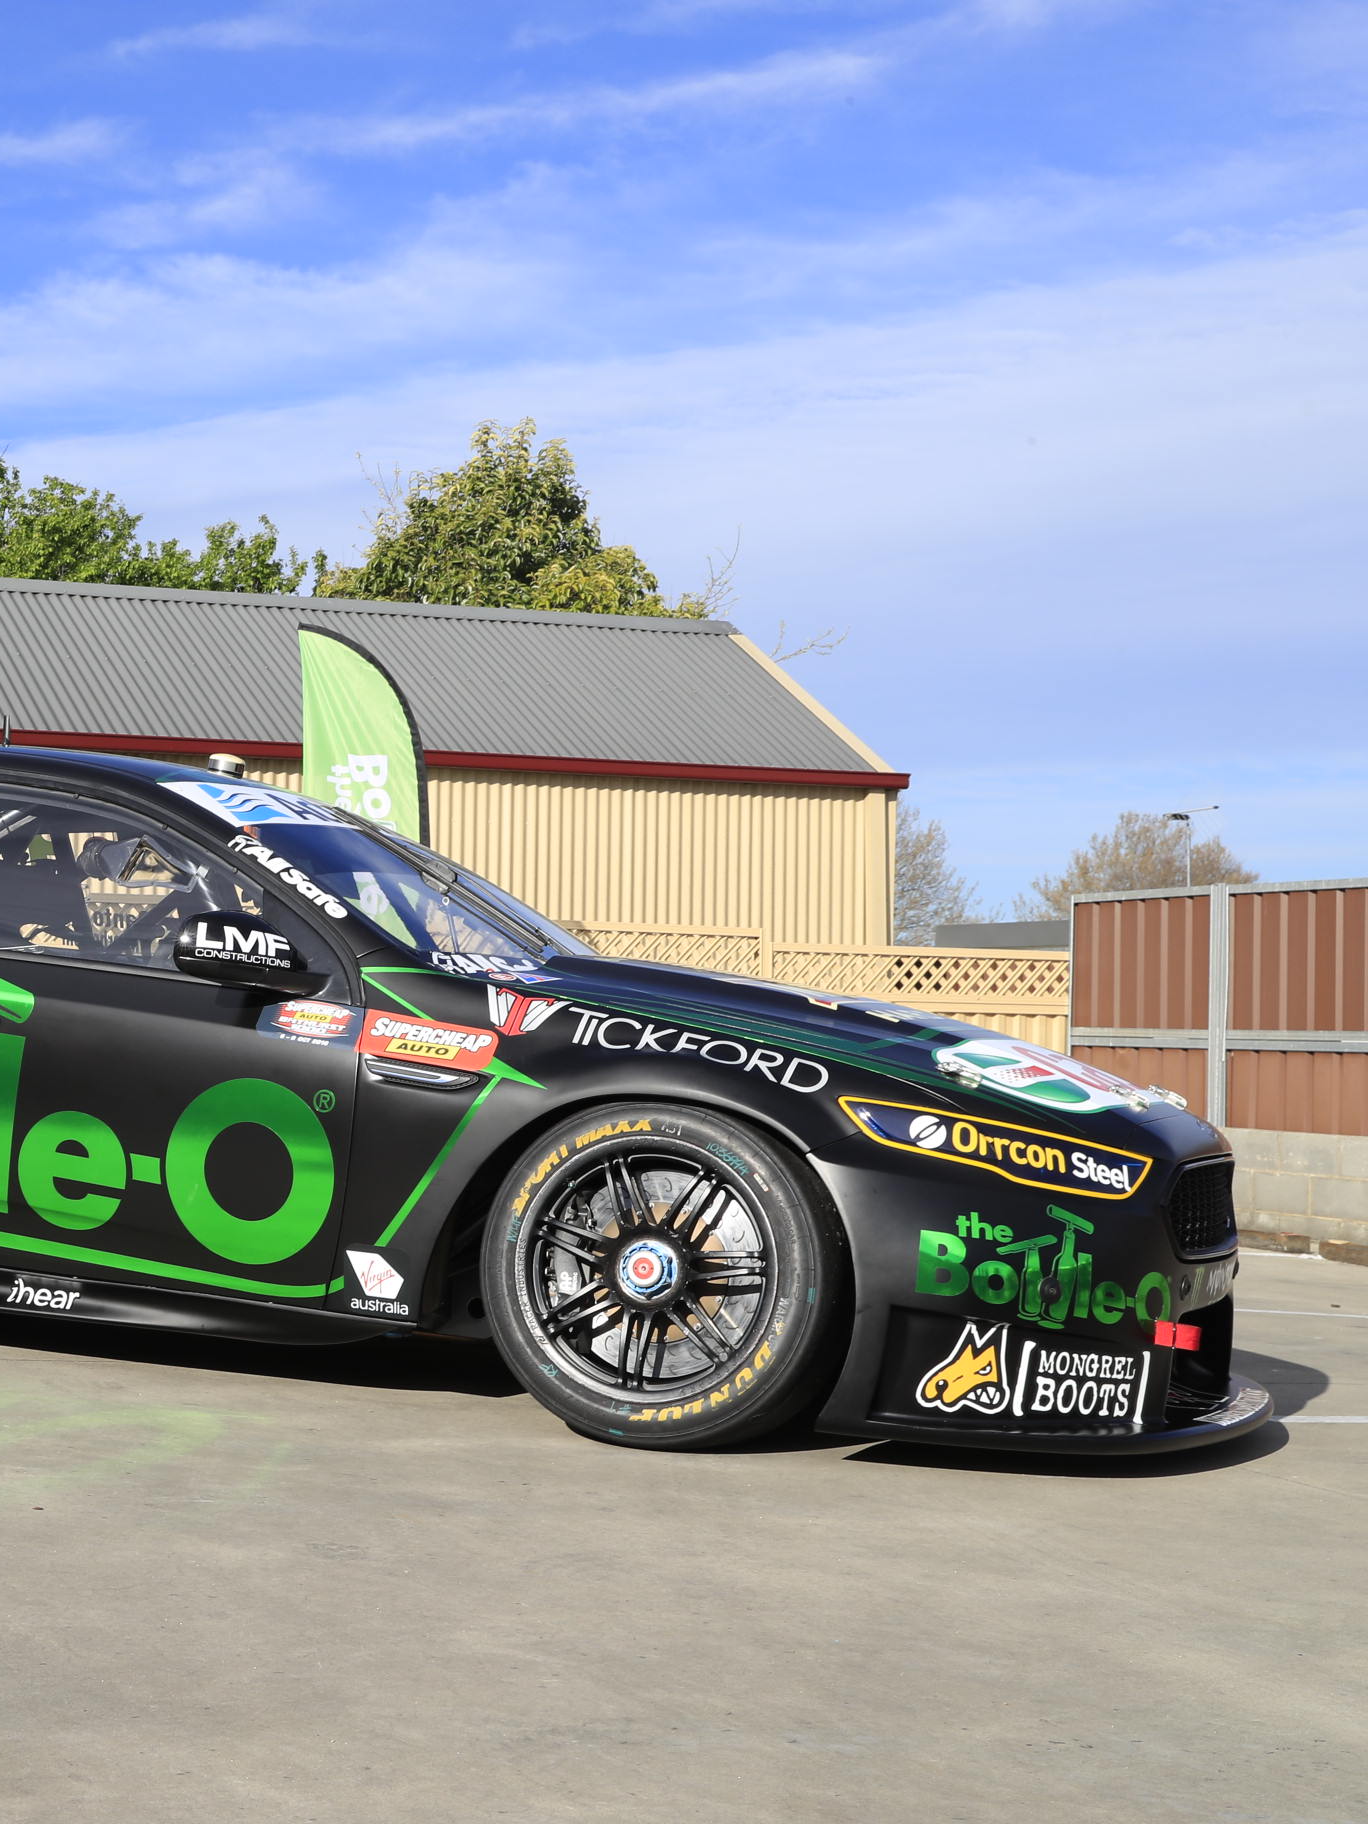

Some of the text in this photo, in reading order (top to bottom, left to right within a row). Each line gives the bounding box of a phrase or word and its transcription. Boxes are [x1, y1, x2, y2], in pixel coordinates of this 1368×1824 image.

[195, 921, 291, 957] LMF
[195, 948, 291, 969] CONSTRUCTIONS
[299, 1013, 328, 1021] AUTO
[370, 1016, 494, 1052] SUPERCHEAP
[396, 1042, 450, 1057] AUTO
[568, 1006, 830, 1094] TICKFORD
[951, 1121, 1066, 1174] Orrcon
[1071, 1152, 1132, 1193] Steel
[955, 1211, 1014, 1243] the
[360, 1260, 396, 1294] Virgin
[914, 1204, 1171, 1336] Bottle-O
[7, 1278, 80, 1310] ihear
[350, 1297, 409, 1316] australia
[1038, 1350, 1136, 1380] MONGREL
[1031, 1376, 1132, 1418] BOOTS
